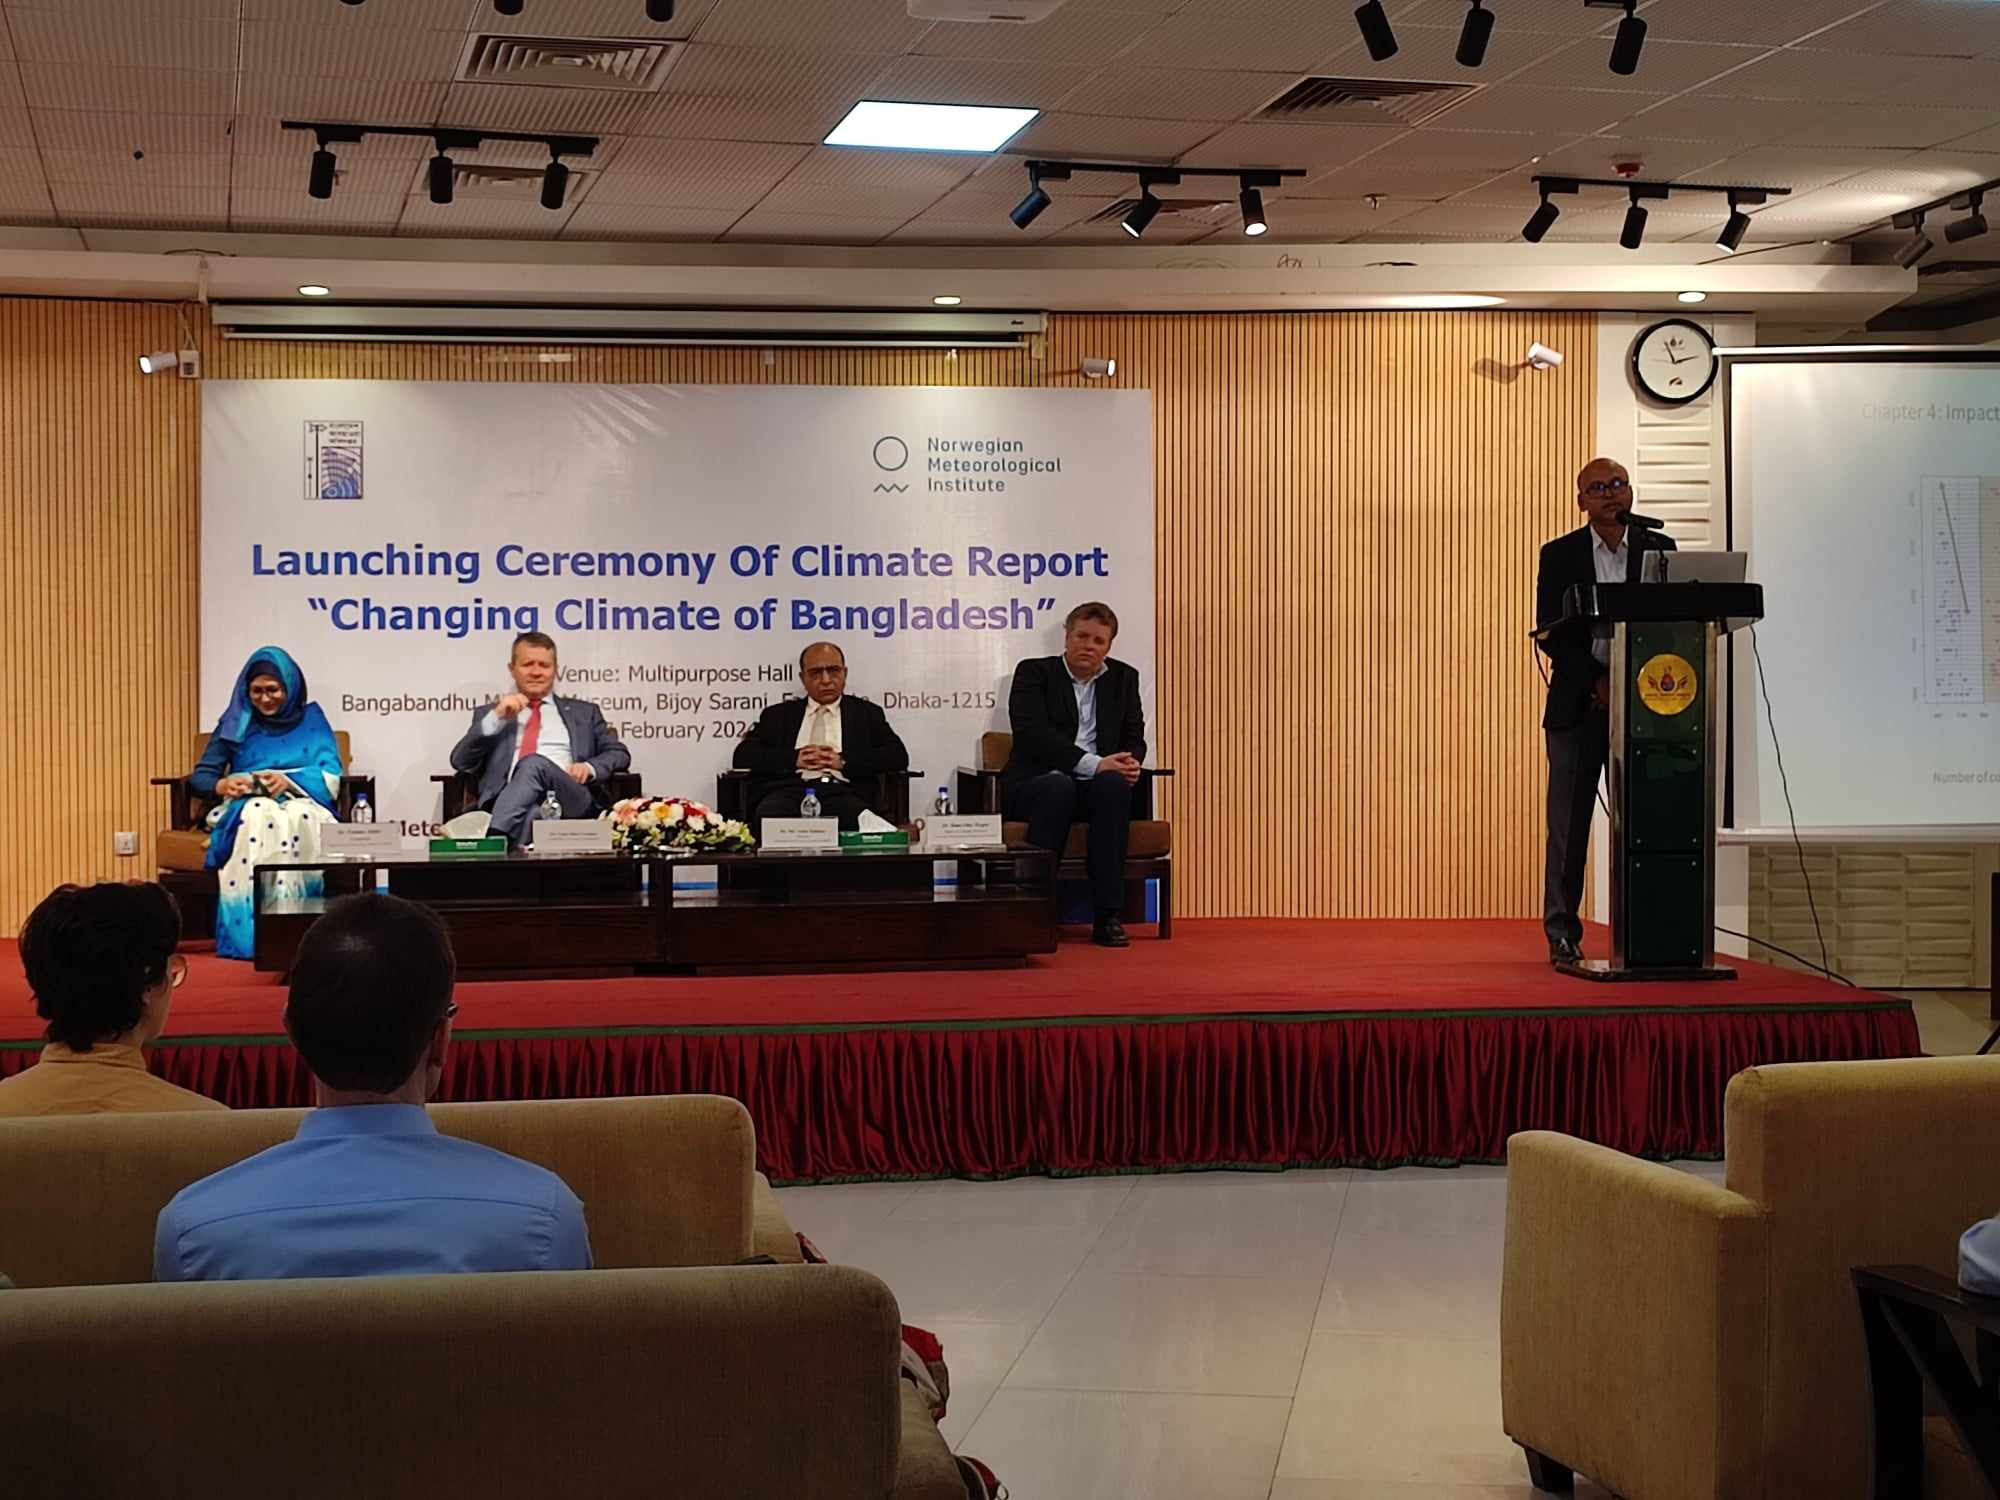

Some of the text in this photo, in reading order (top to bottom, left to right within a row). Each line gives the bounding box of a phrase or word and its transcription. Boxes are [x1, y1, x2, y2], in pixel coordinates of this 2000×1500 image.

[1862, 400, 1922, 424] Chapter
[928, 438, 1023, 455] Norwegian
[928, 457, 1061, 475] Meteorological
[928, 478, 1006, 492] Institute
[252, 544, 1109, 585] Launching Ceremony Of Climate Report
[555, 598, 720, 631] Climate
[734, 598, 778, 631] of
[791, 597, 1056, 638] Bangladesh”
[628, 664, 751, 686] Multipurpose
[758, 664, 793, 682] Hall
[342, 693, 476, 716] Bangabandhu
[656, 693, 702, 715] Bijoy
[883, 691, 996, 709] Dhaka-1215
[621, 721, 705, 742] February
[1976, 770, 1988, 784] of
